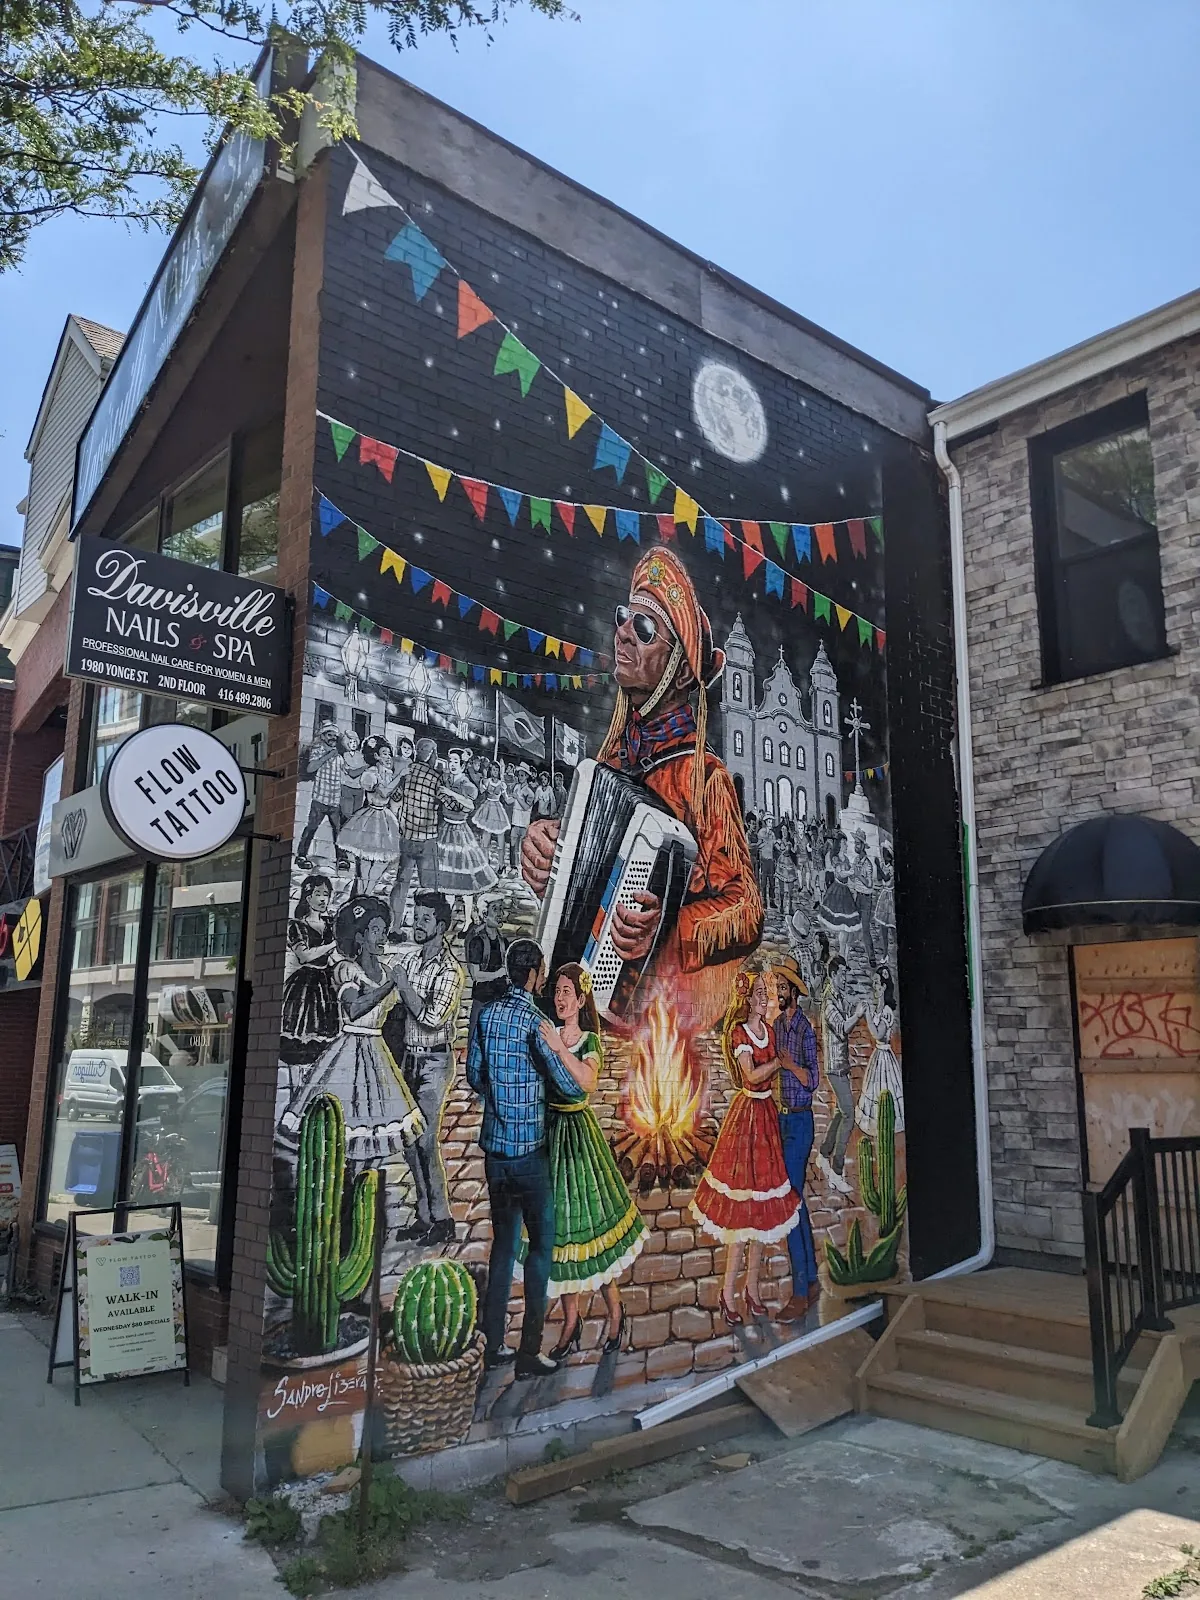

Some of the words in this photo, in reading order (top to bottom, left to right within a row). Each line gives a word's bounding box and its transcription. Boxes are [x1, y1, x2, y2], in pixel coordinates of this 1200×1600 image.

[87, 550, 276, 637] Davisville
[105, 606, 181, 648] NAILS
[212, 633, 256, 667] SPA
[80, 658, 104, 674] 1980
[105, 663, 136, 681] YONGE
[136, 670, 149, 685] ST.
[157, 674, 177, 690] 2ND
[177, 678, 207, 697] FLOOR
[82, 638, 150, 661] PROFESSIONAL
[151, 653, 170, 666] NAIL
[171, 658, 194, 671] CARE
[195, 662, 213, 675] FOR
[214, 667, 245, 683] WOMEN
[246, 674, 254, 684] &
[254, 676, 272, 688] MEN
[134, 743, 202, 805] FLOW
[149, 769, 238, 845] TATTOO
[105, 1289, 159, 1305] WALK-IN
[107, 1305, 156, 1318] AVAILABLE
[93, 1323, 131, 1333] WEDNESDAY
[143, 1317, 171, 1327] SPECIALS
